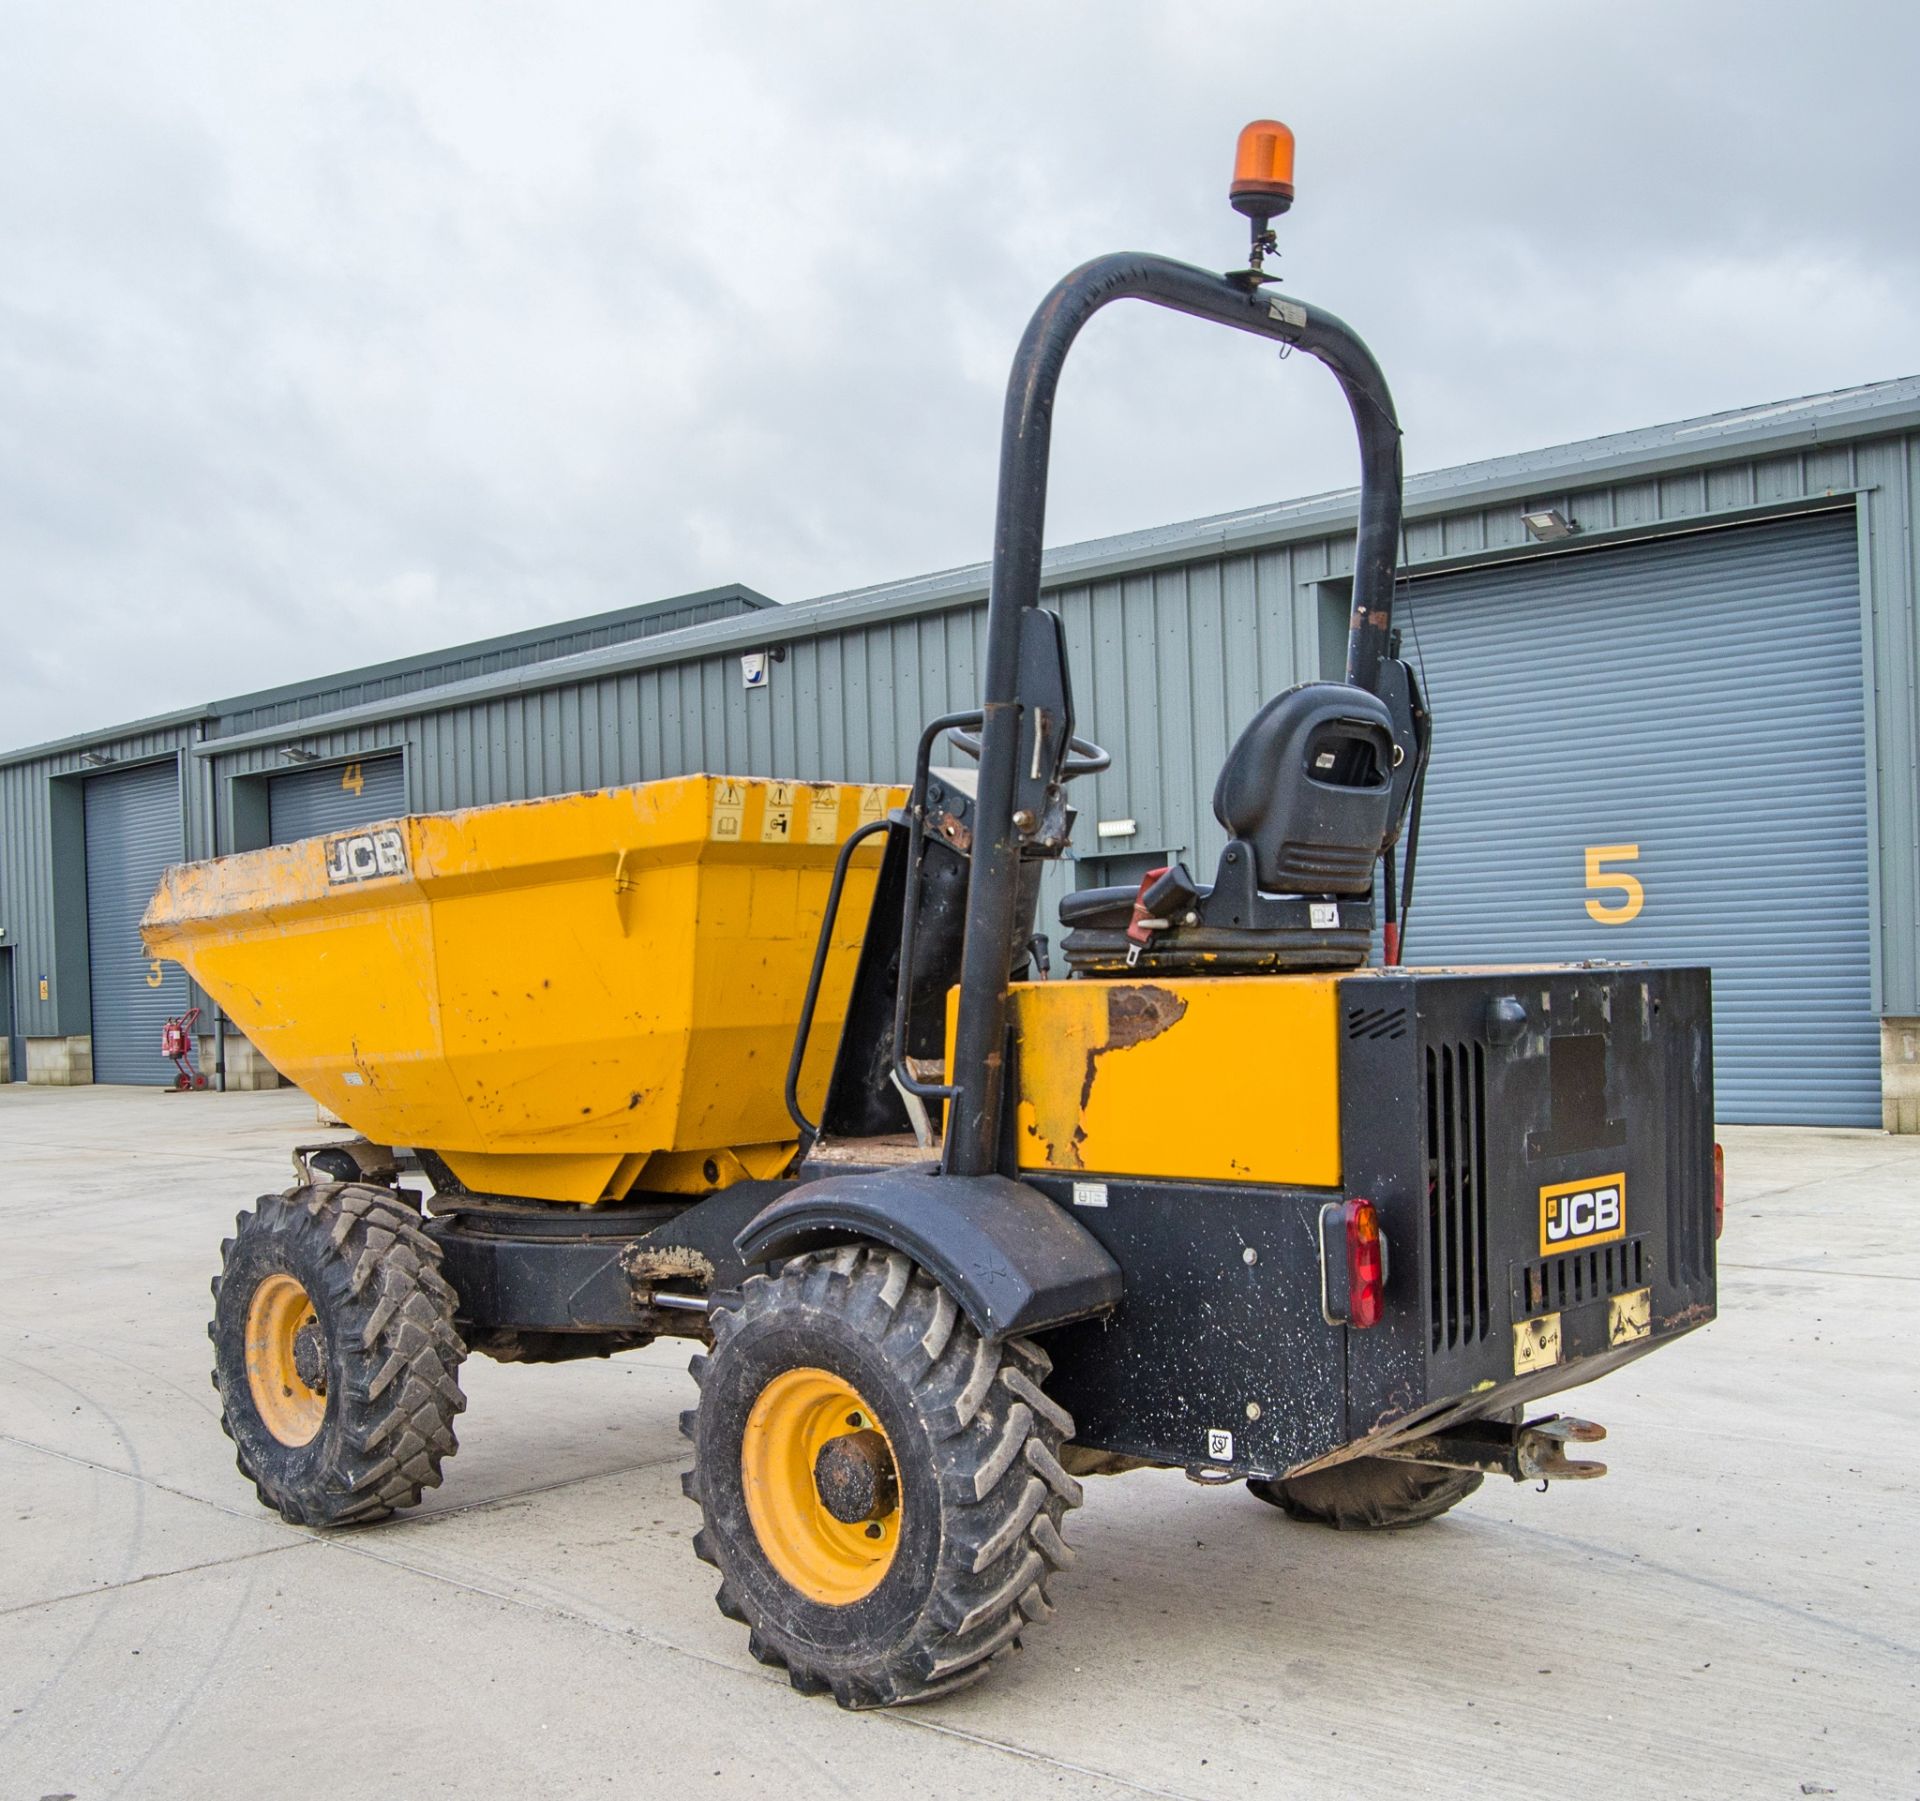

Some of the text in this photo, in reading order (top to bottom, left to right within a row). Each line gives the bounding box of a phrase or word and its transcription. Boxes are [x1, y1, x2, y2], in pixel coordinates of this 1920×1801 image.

[343, 763, 365, 796] 4
[328, 830, 407, 881] JCB
[1584, 844, 1645, 925] 5
[1547, 1188, 1620, 1240] JCB
